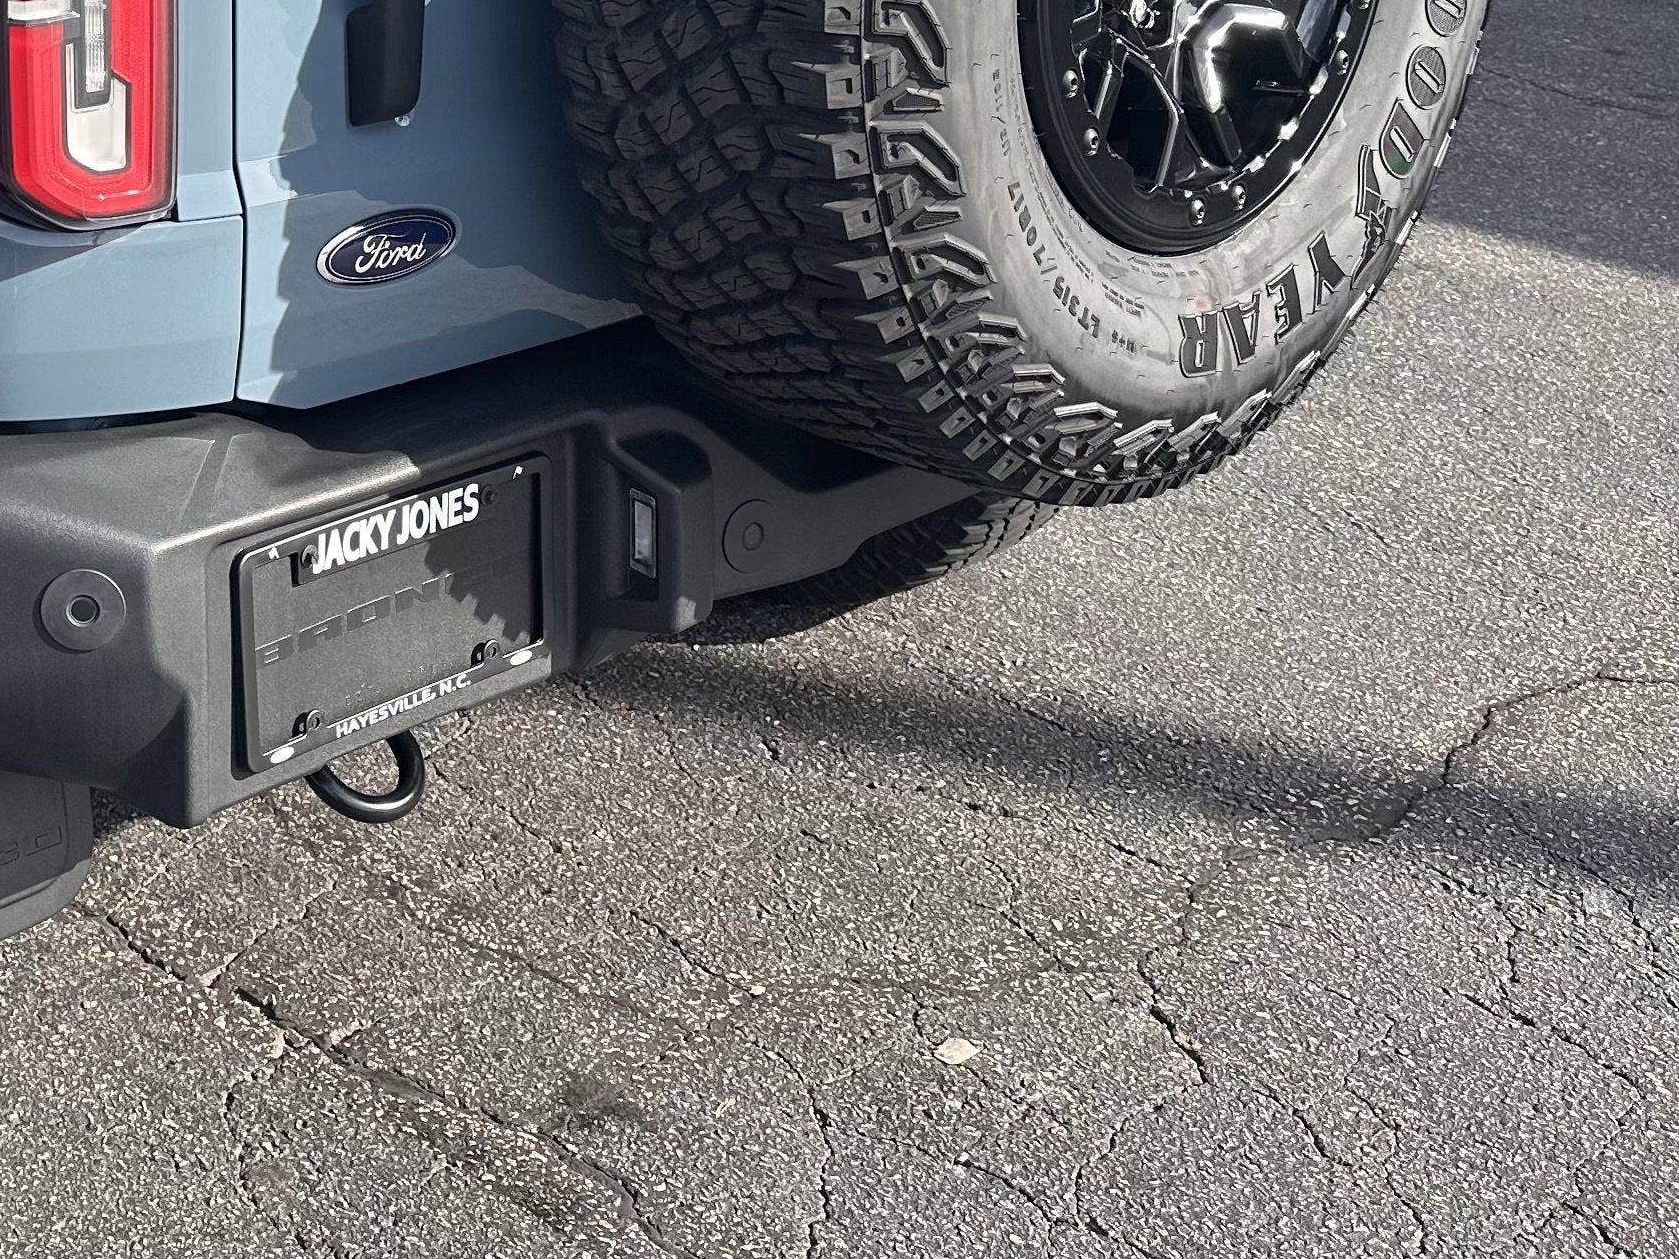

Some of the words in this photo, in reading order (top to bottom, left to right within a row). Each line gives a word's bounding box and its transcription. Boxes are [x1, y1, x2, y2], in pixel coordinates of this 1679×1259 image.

[354, 231, 428, 274] Ford
[310, 508, 397, 575] JACKY
[396, 482, 480, 546] JONES
[335, 687, 437, 739] HAYESVILLE,
[439, 672, 472, 699] N.C.
